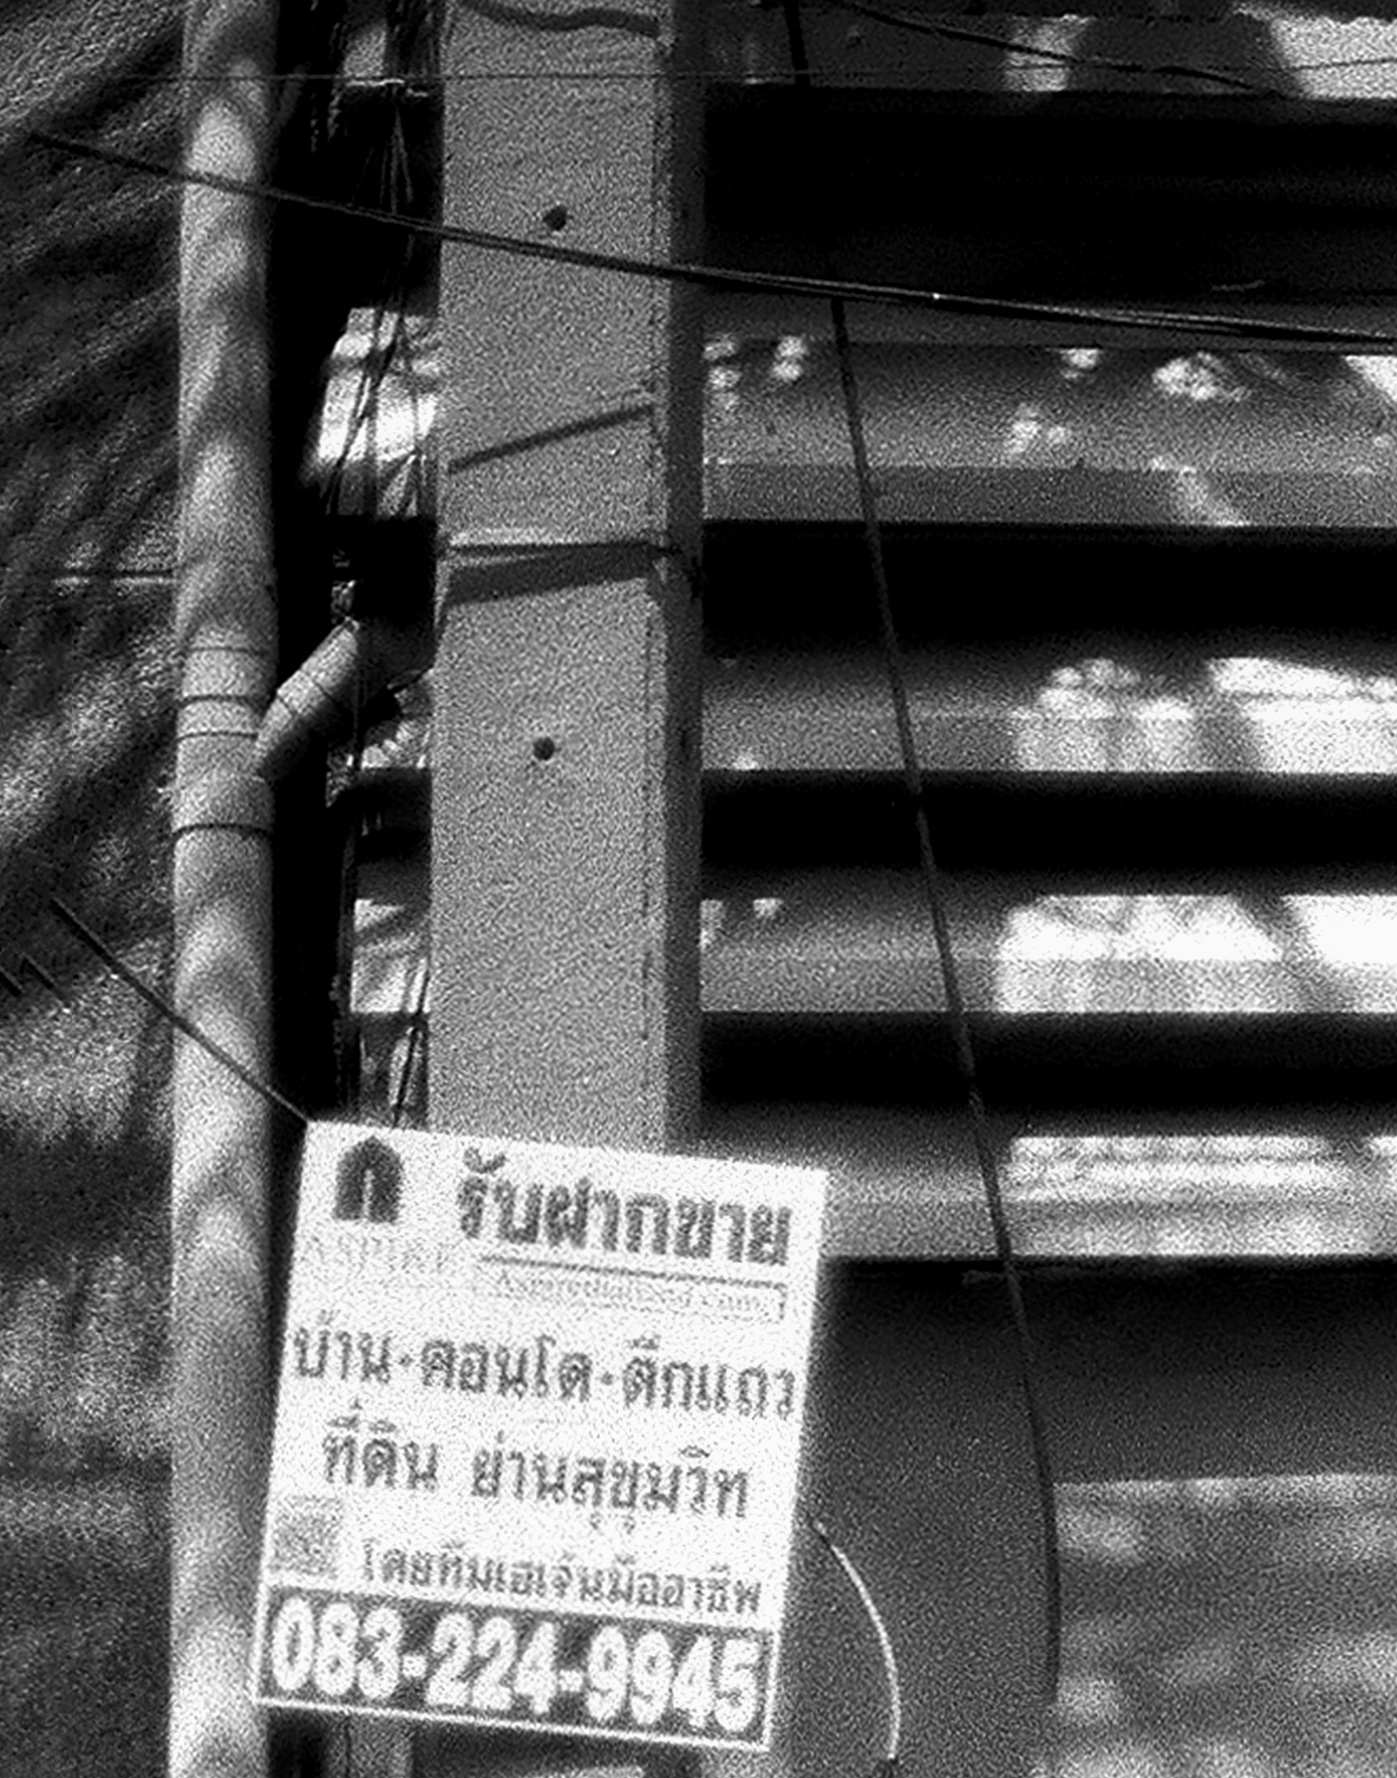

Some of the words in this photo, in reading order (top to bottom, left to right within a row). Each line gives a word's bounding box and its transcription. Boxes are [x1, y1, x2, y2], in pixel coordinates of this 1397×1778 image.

[457, 1146, 792, 1266] รับฝากขาย
[322, 1398, 440, 1490] ที่ดิน
[469, 1431, 752, 1533] ย่านสุขุมวิท
[269, 1600, 762, 1730] 083-224-9945
